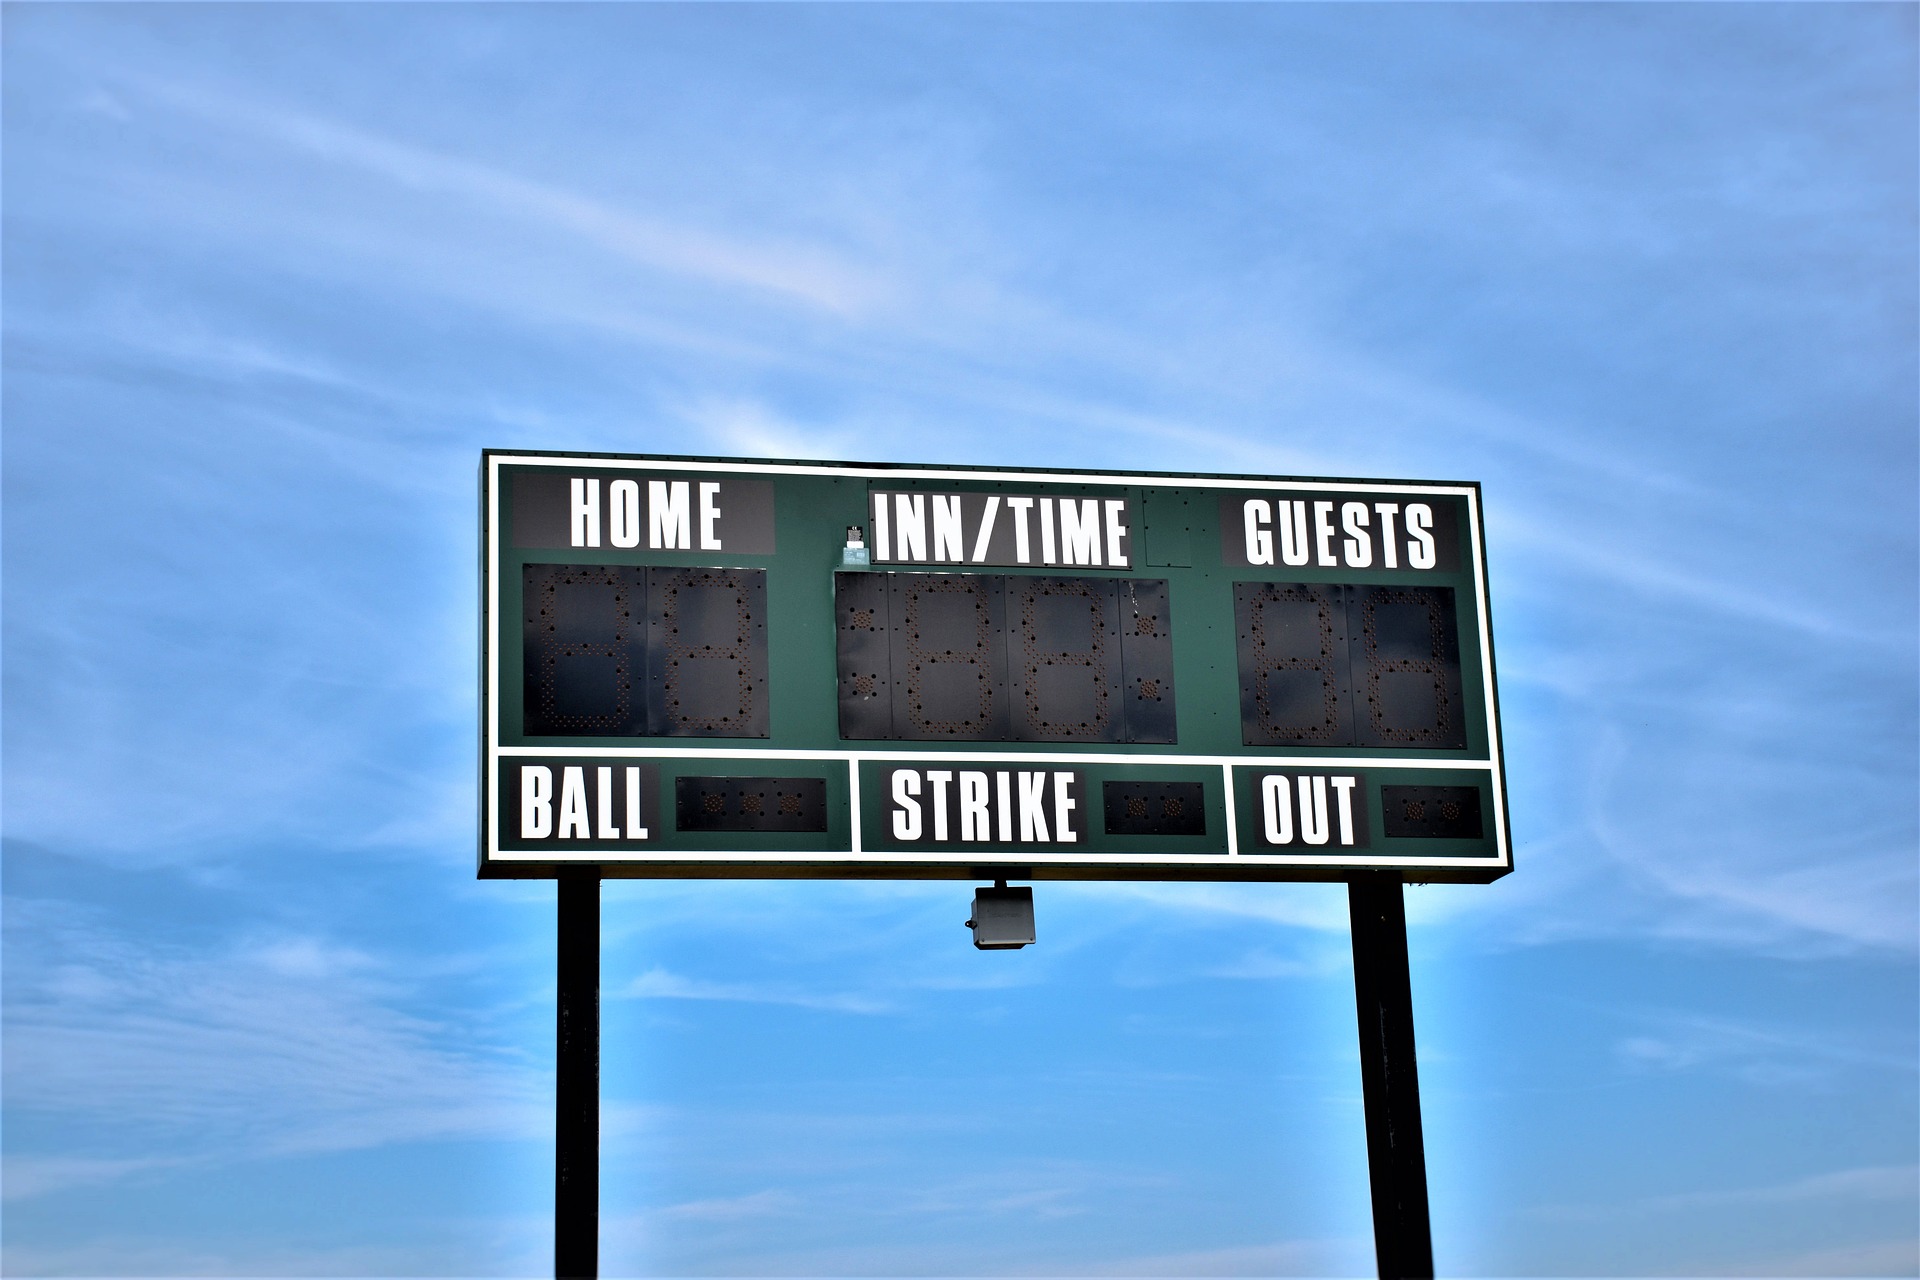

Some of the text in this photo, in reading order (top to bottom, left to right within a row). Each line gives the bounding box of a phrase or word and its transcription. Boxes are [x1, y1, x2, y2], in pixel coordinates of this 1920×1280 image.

[571, 479, 722, 551] HOME
[874, 494, 1128, 567] INN/TIME
[1244, 499, 1436, 569] GUESTS
[521, 766, 649, 840] BALL
[892, 769, 1077, 843] STRIKE
[1261, 774, 1356, 845] OUT
